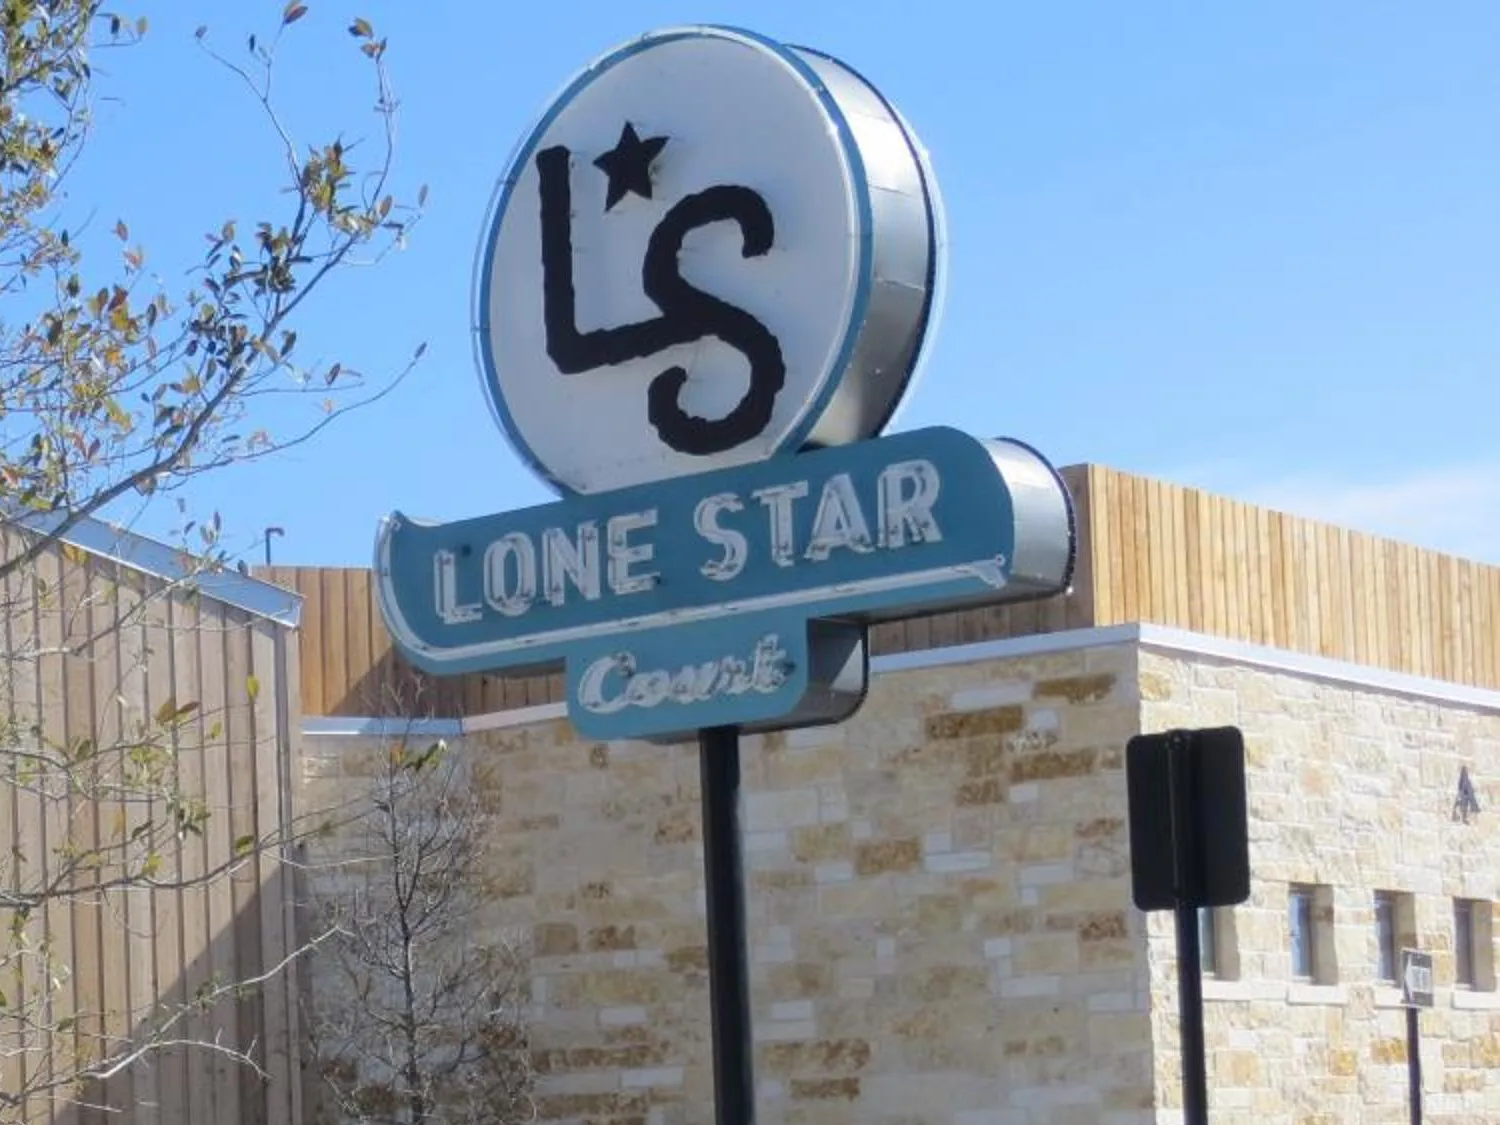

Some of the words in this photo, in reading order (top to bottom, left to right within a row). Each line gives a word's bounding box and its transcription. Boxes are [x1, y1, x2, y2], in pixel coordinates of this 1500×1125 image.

[432, 508, 660, 625] LONE
[692, 458, 943, 582] STAR
[577, 633, 790, 714] Court
